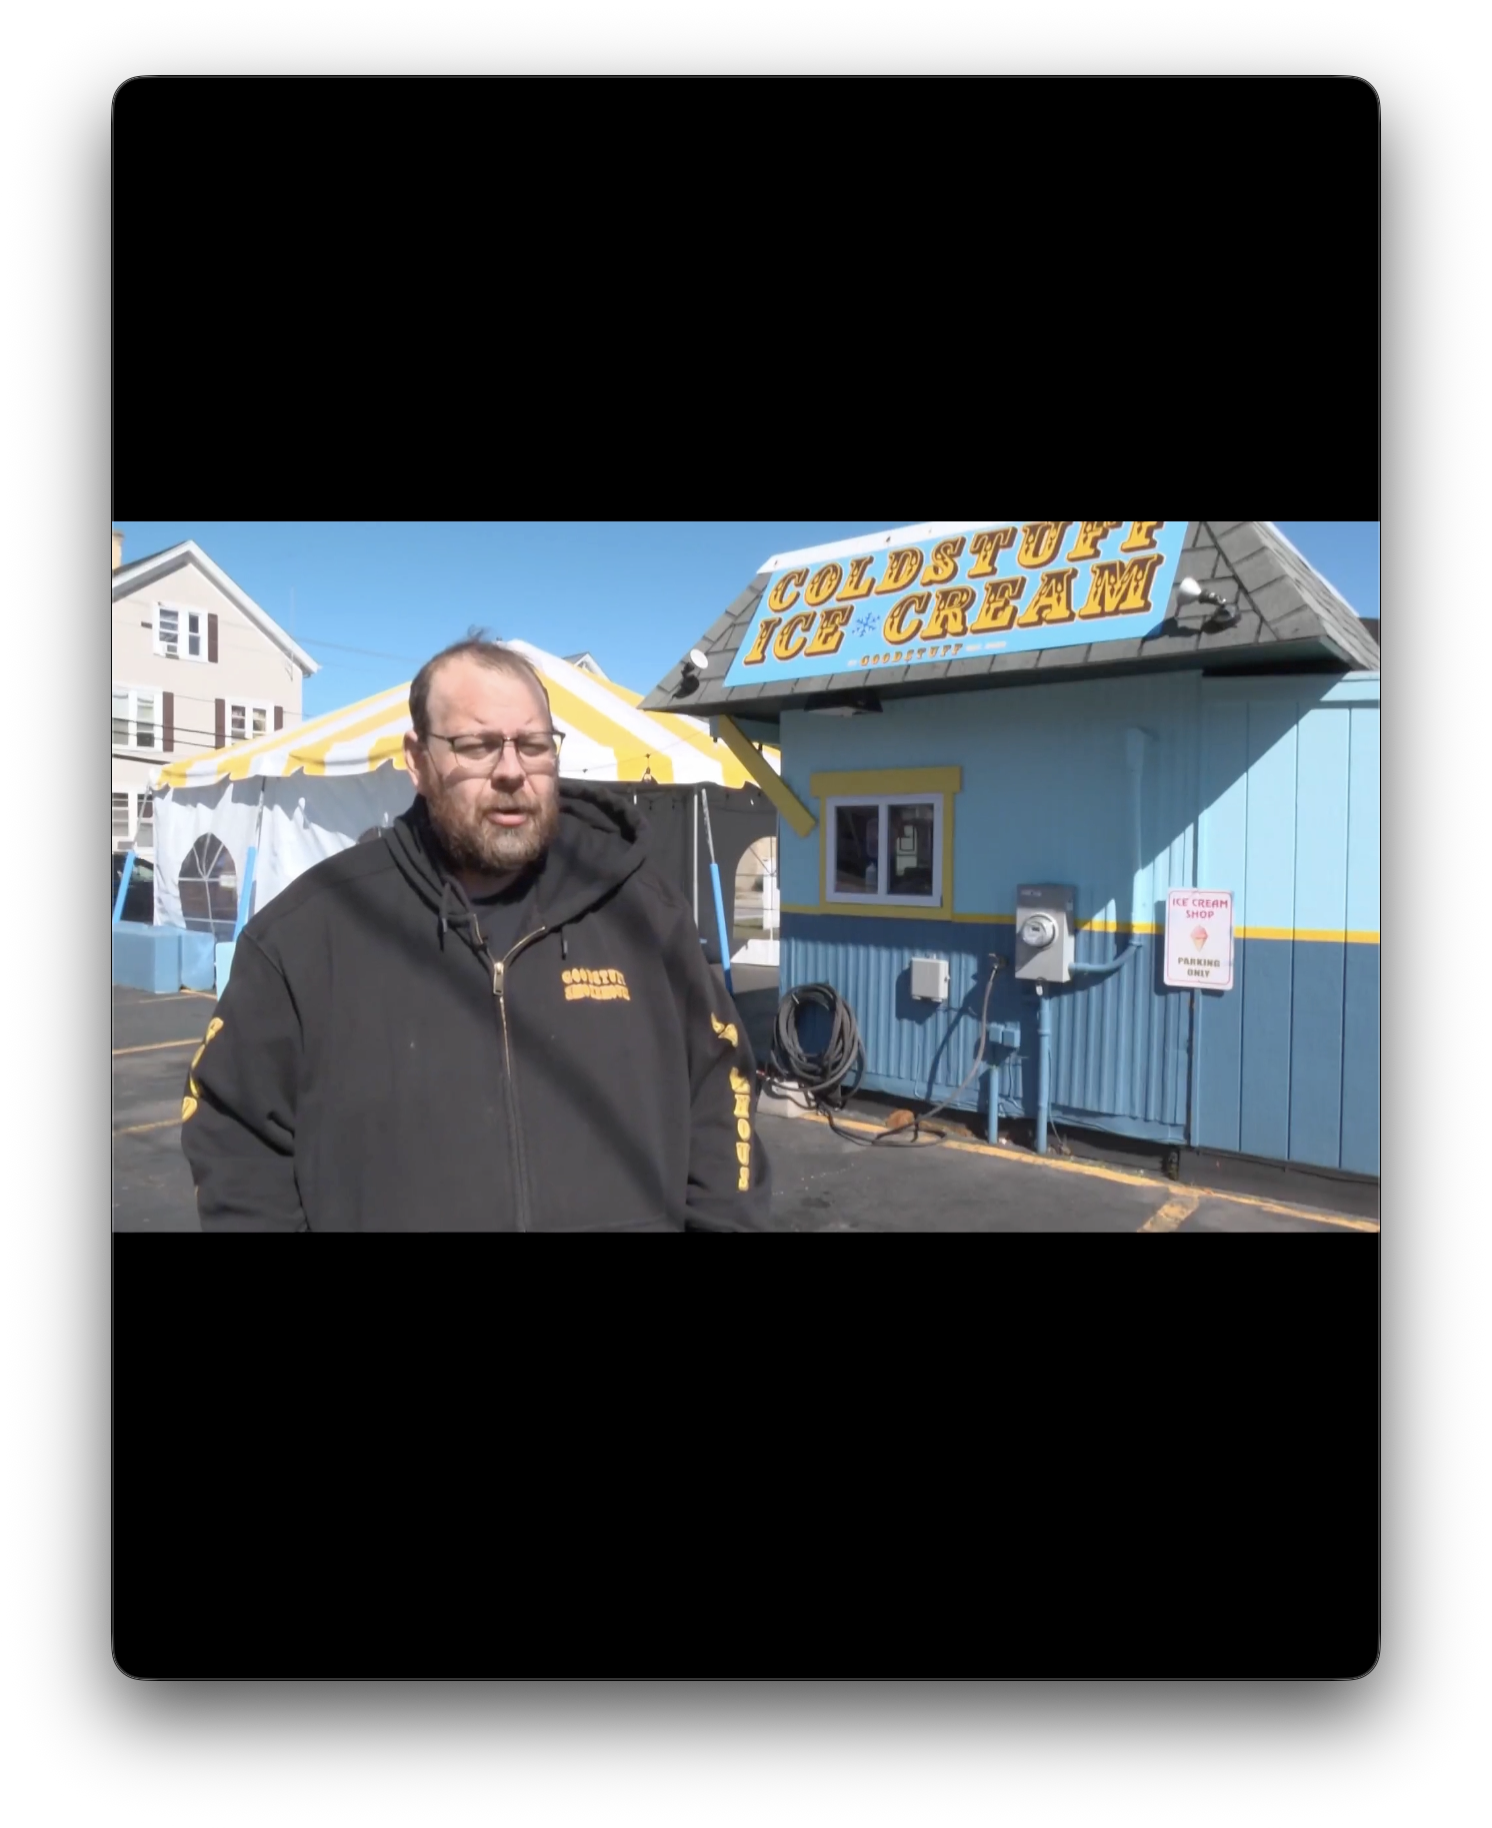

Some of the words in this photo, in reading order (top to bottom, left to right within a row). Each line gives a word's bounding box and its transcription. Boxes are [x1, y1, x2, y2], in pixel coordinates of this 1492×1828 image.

[768, 521, 1165, 613] COLDSTUFF
[743, 604, 855, 666] ICE
[882, 553, 1165, 646] CREAM
[860, 643, 963, 666] GOODSTUFF
[1172, 898, 1189, 907] ICE
[1192, 899, 1228, 909] CREAM
[1186, 910, 1215, 919] SHOP
[1178, 957, 1220, 967] PARKING
[1187, 969, 1210, 978] ONLY
